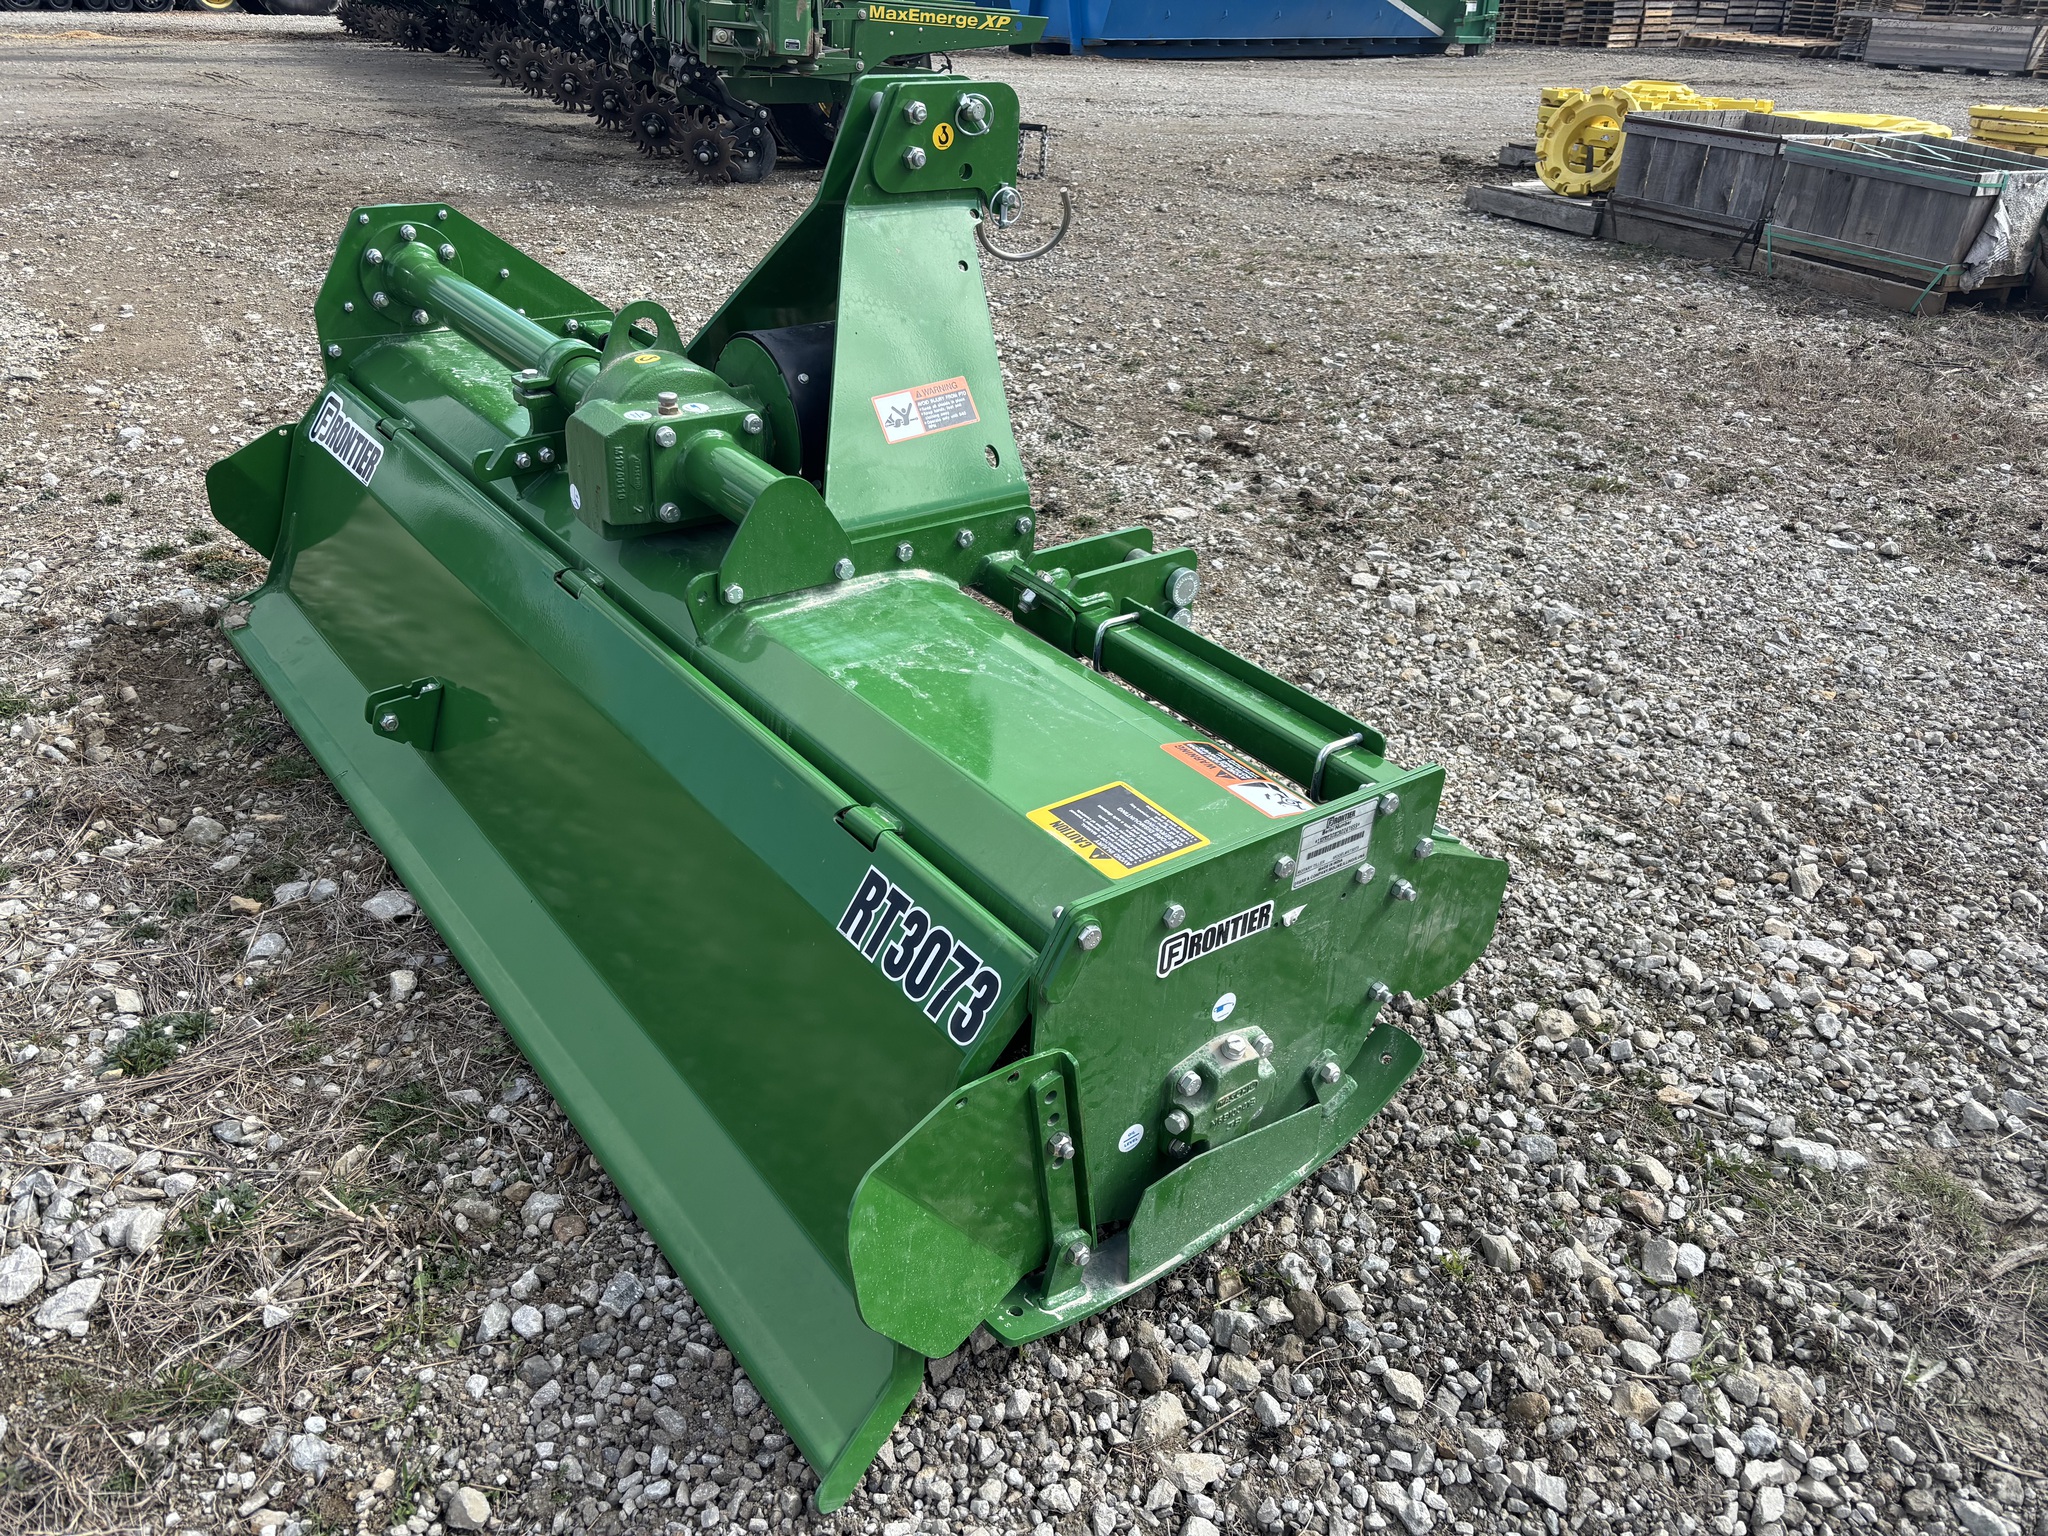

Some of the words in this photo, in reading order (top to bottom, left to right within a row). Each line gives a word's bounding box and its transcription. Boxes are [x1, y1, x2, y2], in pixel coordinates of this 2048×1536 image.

[869, 5, 978, 28] MaxEmerge
[977, 14, 1011, 30] XP
[921, 381, 958, 396] WARNING
[311, 395, 382, 483] FRONTIER
[1174, 744, 1217, 770] WARNING
[1326, 810, 1356, 829] FRONTIER
[1048, 820, 1093, 848] CAUTION
[1158, 903, 1272, 975] FRONTIER
[837, 865, 1001, 1046] RT3073
